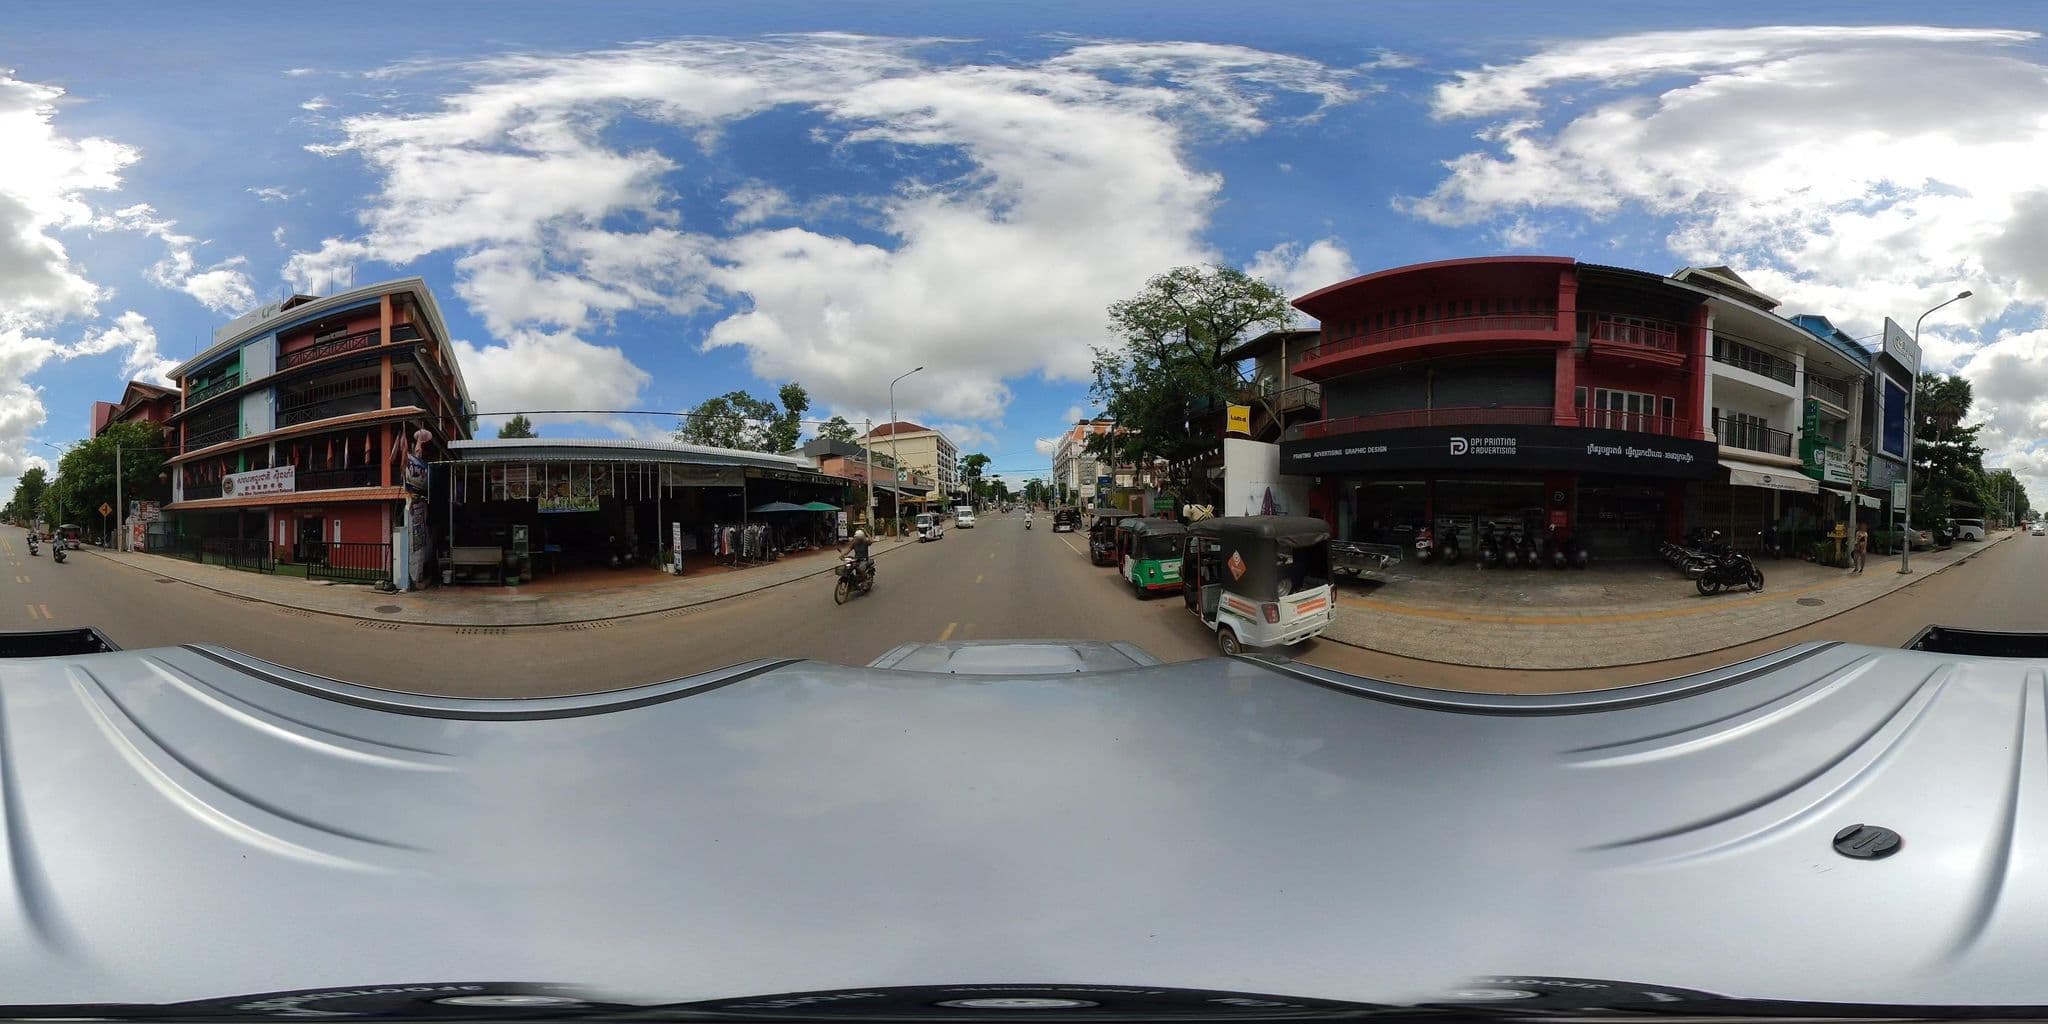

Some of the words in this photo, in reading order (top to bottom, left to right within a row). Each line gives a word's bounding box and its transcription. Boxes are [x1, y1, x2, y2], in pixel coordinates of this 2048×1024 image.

[1484, 438, 1516, 446] PRINTING
[1313, 449, 1342, 457] ADVERTISING
[1345, 447, 1366, 455] GRAPHIC
[1367, 446, 1387, 454] DESIGN
